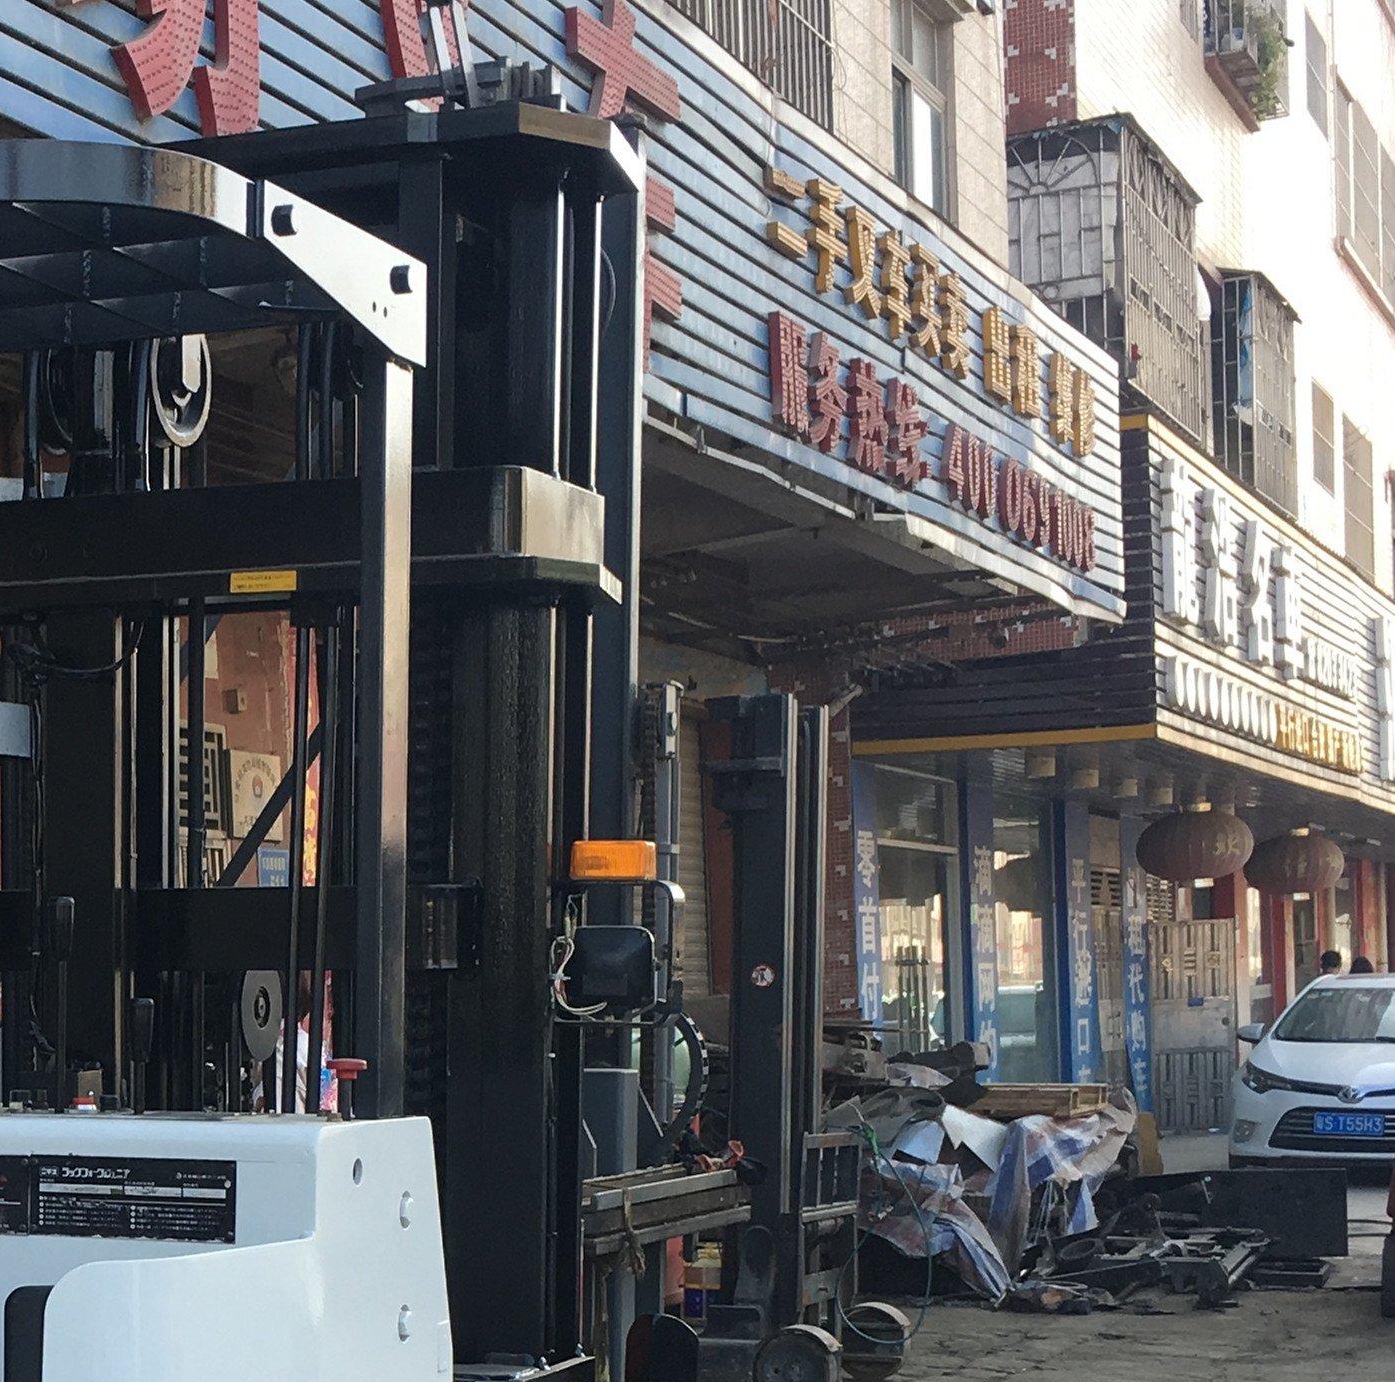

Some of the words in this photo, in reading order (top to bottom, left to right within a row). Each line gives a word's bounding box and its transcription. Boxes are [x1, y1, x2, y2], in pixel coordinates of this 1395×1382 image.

[763, 165, 971, 381] 二手叉车买卖
[982, 305, 1041, 419] 出租
[768, 310, 932, 491] 服务热线
[856, 830, 881, 1021] 零首付
[973, 845, 999, 1083] 滴滴网约
